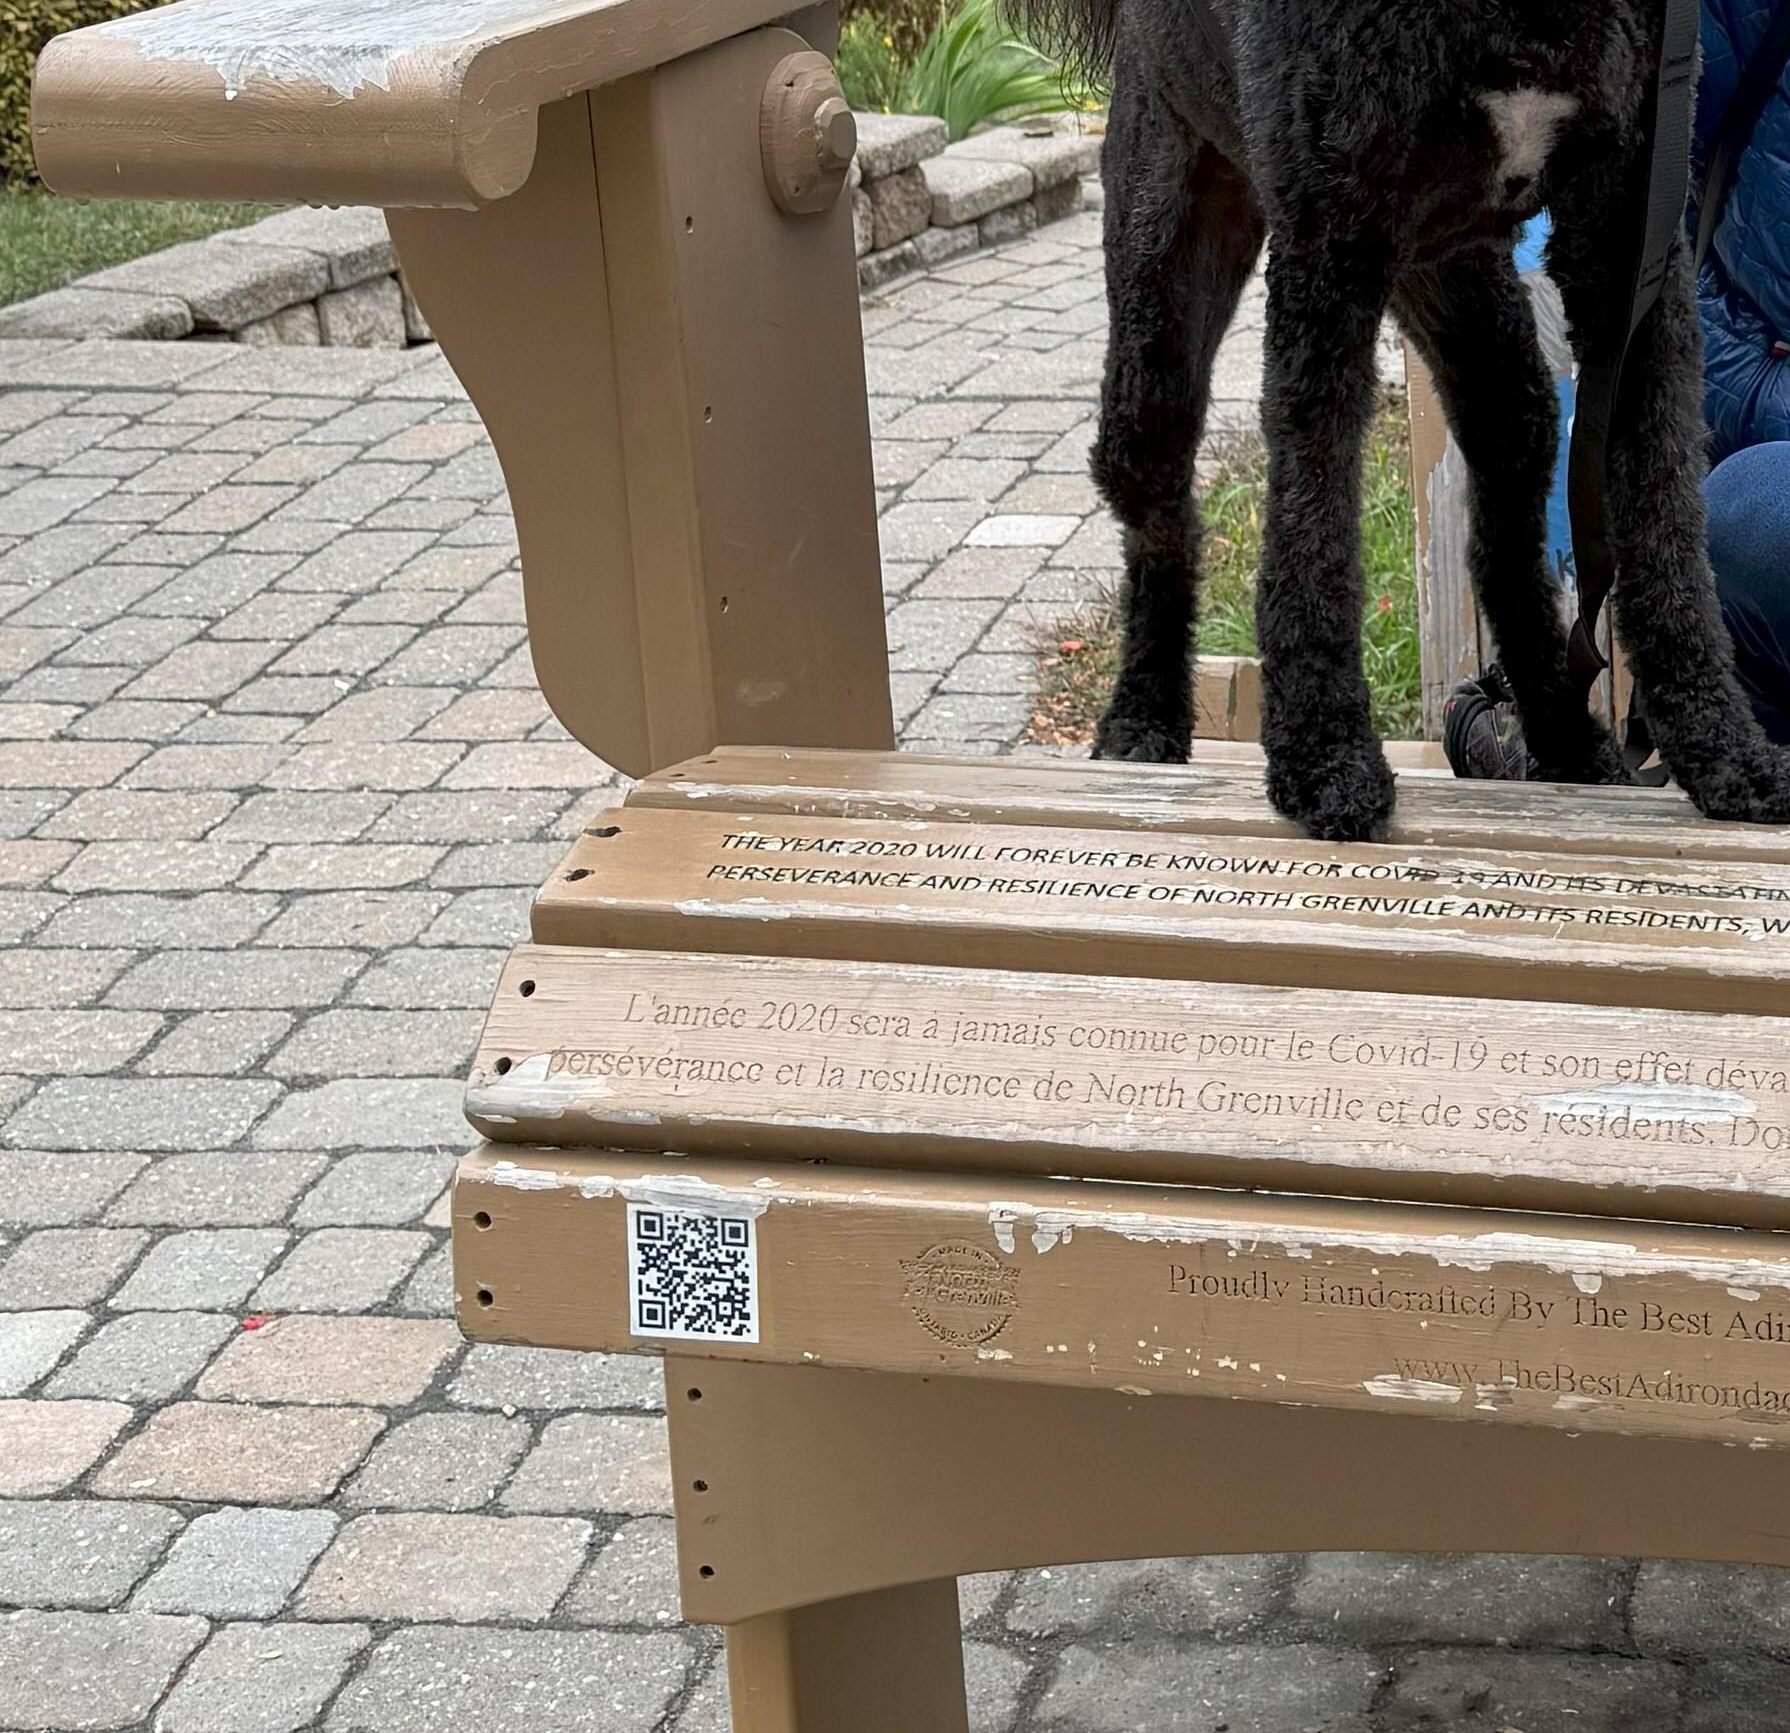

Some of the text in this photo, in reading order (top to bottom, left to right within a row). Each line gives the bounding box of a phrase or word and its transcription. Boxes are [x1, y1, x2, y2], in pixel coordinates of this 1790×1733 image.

[706, 863, 917, 888] PERSEVERANCE
[919, 874, 981, 892] AND
[988, 877, 1138, 901] RESILIENCE
[1148, 886, 1190, 902] OF
[1191, 888, 1294, 908] NORTH
[1301, 894, 1457, 916] GRENVILLE
[1461, 901, 1524, 918] AND
[1533, 905, 1575, 923] ITS
[1585, 909, 1750, 936] RESIDENTS,
[721, 834, 770, 852] THE
[777, 837, 844, 855] YEAR
[849, 840, 917, 857] 2020
[924, 843, 986, 862] WILL
[995, 847, 1119, 868] FOREVER
[1126, 853, 1158, 868] BE
[1166, 855, 1280, 875] KNOWN
[1286, 862, 1340, 878] FOR
[1492, 871, 1557, 889] AND
[1565, 876, 1606, 892] ITS
[623, 994, 747, 1028] L'année
[760, 1001, 838, 1035] 2020
[846, 1013, 910, 1038] sera
[950, 1011, 1057, 1046] jamais
[1069, 1025, 1187, 1054] connue
[1197, 1028, 1275, 1068] pour
[1286, 1030, 1314, 1062] le
[1327, 1032, 1490, 1072] Covid-19
[1500, 1049, 1532, 1075] et
[1541, 1054, 1600, 1079] son
[1615, 1050, 1693, 1083] effet
[544, 1045, 764, 1084] persévérance
[775, 1059, 804, 1087] et
[820, 1058, 844, 1090] la
[1033, 1069, 1074, 1102] de
[1080, 1071, 1184, 1111] North
[1198, 1079, 1364, 1122] Grenville
[1376, 1093, 1405, 1125] et
[1421, 1092, 1463, 1128] de
[1473, 1105, 1530, 1134] ses
[1541, 1101, 1714, 1147] résidents.
[1168, 1264, 1290, 1307] Proudly
[1301, 1275, 1497, 1319] Handcrafted
[1508, 1289, 1554, 1329] By
[1567, 1294, 1629, 1329] The
[1640, 1300, 1714, 1337] Best
